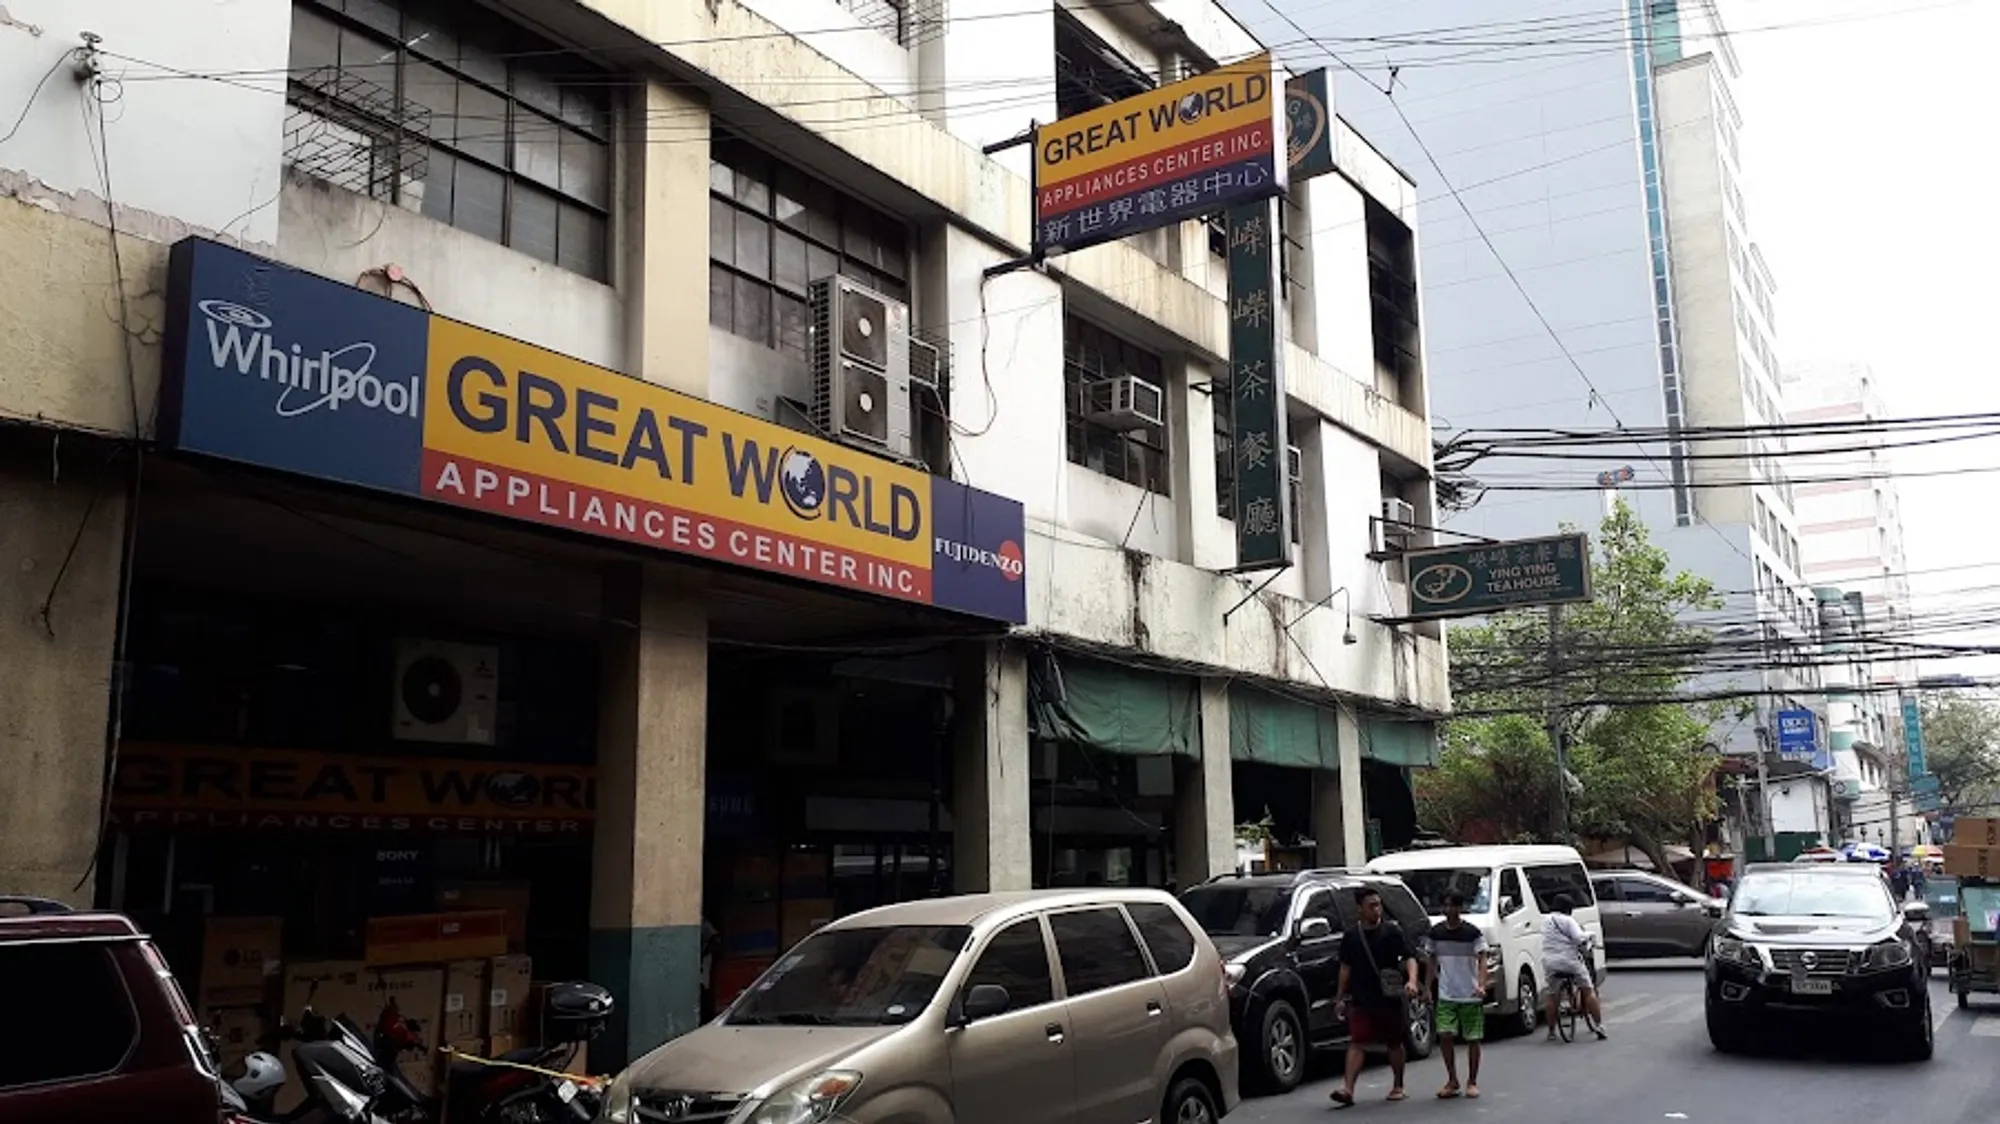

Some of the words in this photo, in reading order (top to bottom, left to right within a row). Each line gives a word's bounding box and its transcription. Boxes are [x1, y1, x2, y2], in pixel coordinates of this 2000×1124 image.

[1043, 112, 1142, 166] GREAT
[1149, 74, 1267, 133] WORLD
[1042, 161, 1149, 208] APPLIANCES
[1152, 139, 1225, 176] CENTER
[1230, 129, 1269, 154] INC.
[1043, 161, 1269, 244] 新世界電器中心
[205, 318, 420, 418] Whirlpool
[446, 355, 708, 485] GREAT
[721, 431, 922, 542] WORLD
[436, 460, 717, 551] APPLIANCES
[728, 528, 858, 583] CENTER
[867, 561, 923, 597] INC.
[934, 536, 1024, 575] FUJIDENZO
[1486, 578, 1513, 593] TEA
[1513, 574, 1562, 591] HOUSE
[1488, 565, 1523, 579] YING
[1523, 562, 1557, 576] YING
[116, 753, 399, 803] GREAT
[375, 849, 419, 862] SONY
[427, 817, 581, 834] CENTER
